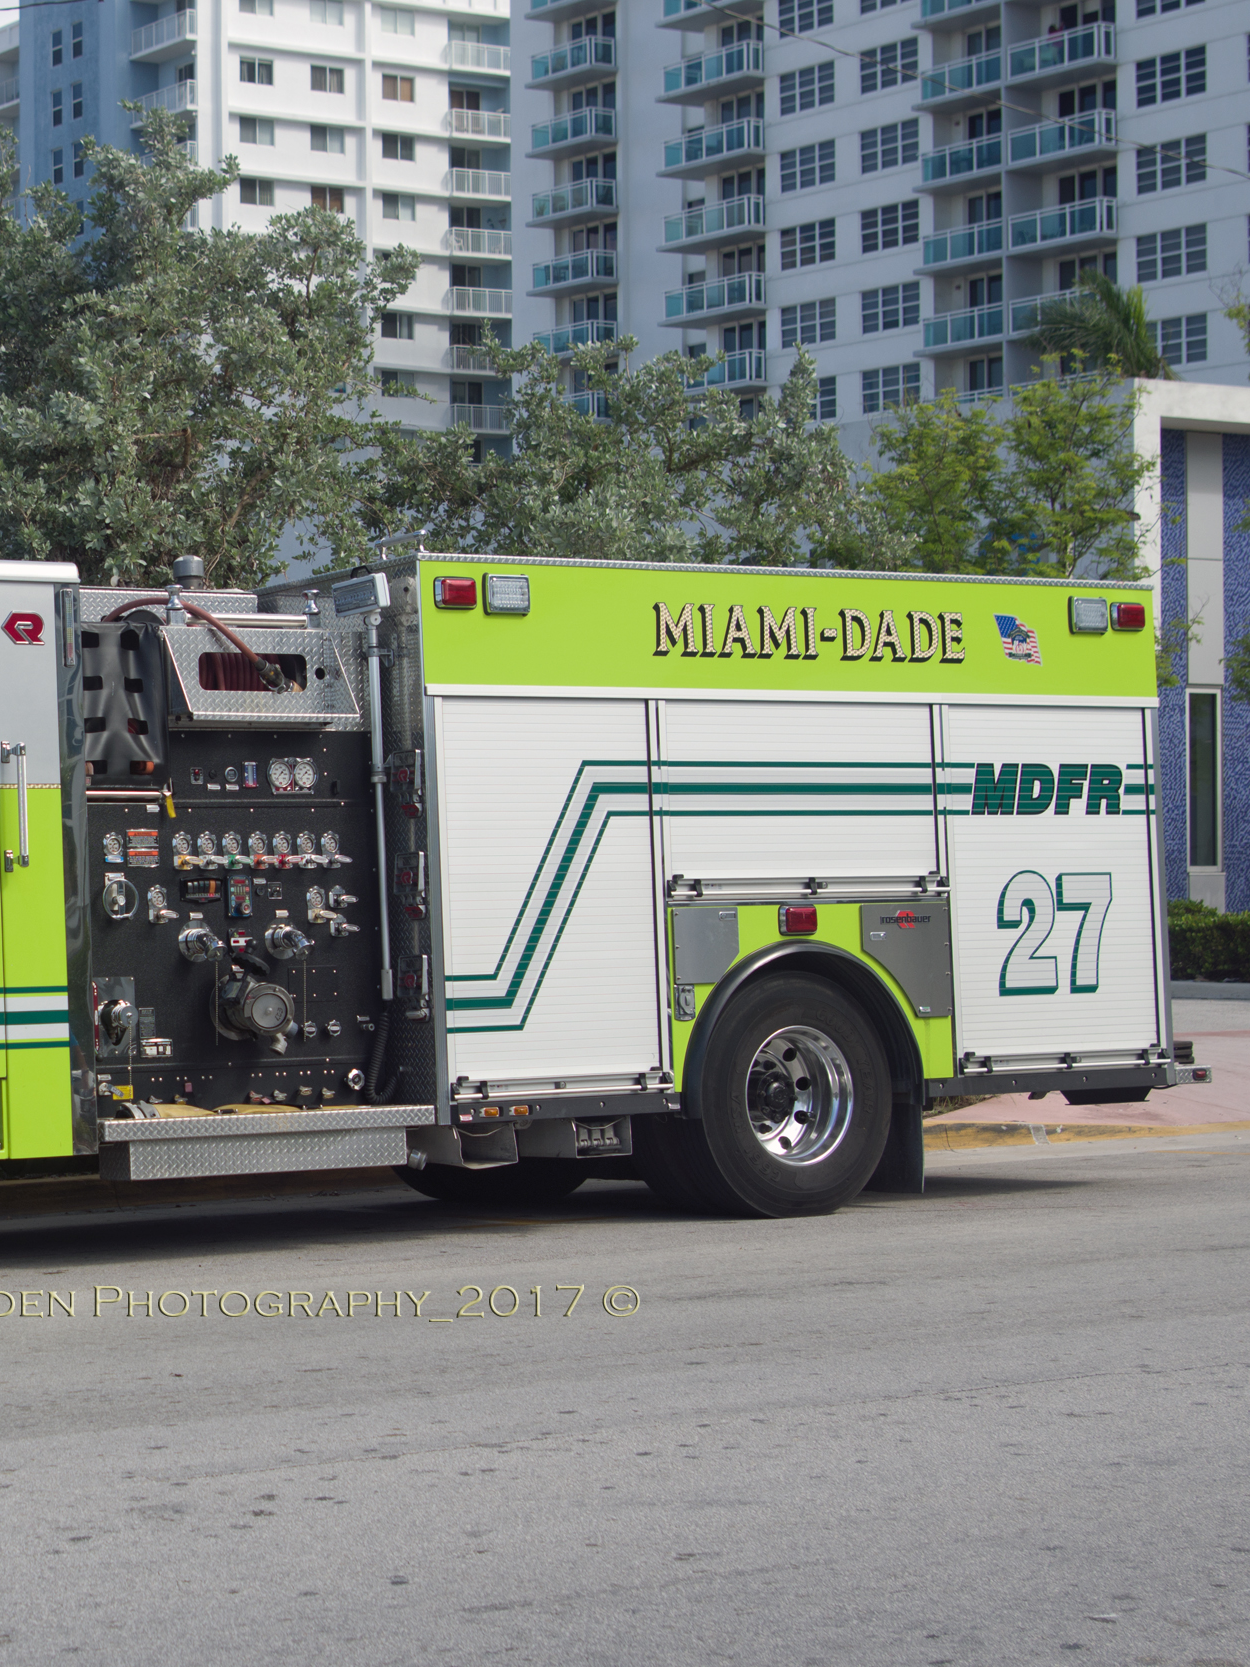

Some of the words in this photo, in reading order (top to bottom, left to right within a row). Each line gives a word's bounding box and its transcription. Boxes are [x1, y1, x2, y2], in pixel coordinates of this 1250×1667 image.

[652, 601, 966, 664] MIAMI-DADE
[971, 763, 1125, 815] MDFR
[996, 870, 1113, 995] 27
